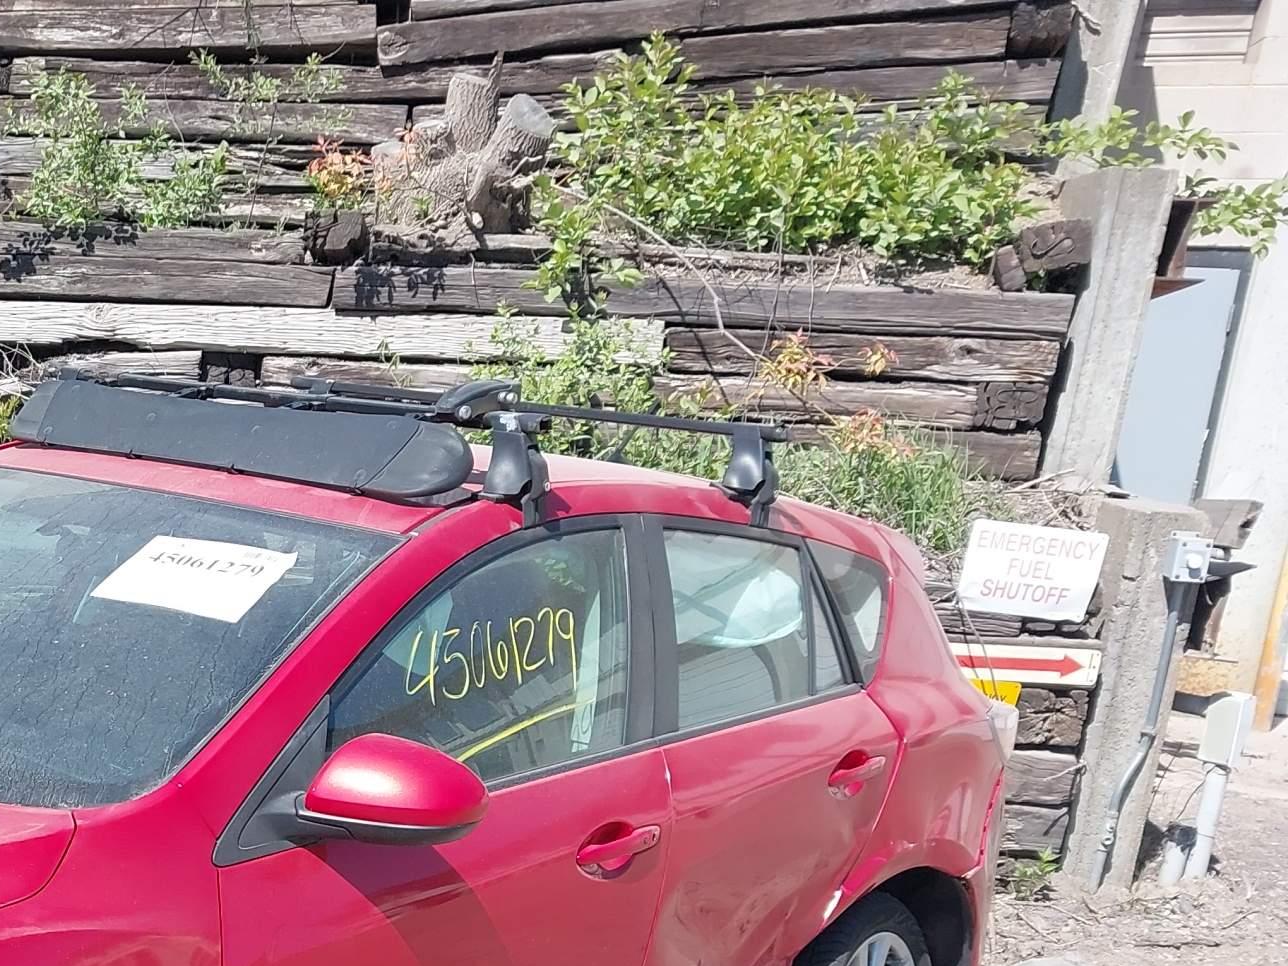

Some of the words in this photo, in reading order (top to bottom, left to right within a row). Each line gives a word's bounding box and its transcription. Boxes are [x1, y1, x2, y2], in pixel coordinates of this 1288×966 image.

[977, 529, 1100, 560] EMERGENCY
[148, 551, 265, 577] 45061279
[1006, 557, 1055, 581] FUEL
[980, 578, 1071, 605] SHUTOFF
[405, 606, 578, 706] 45061279
